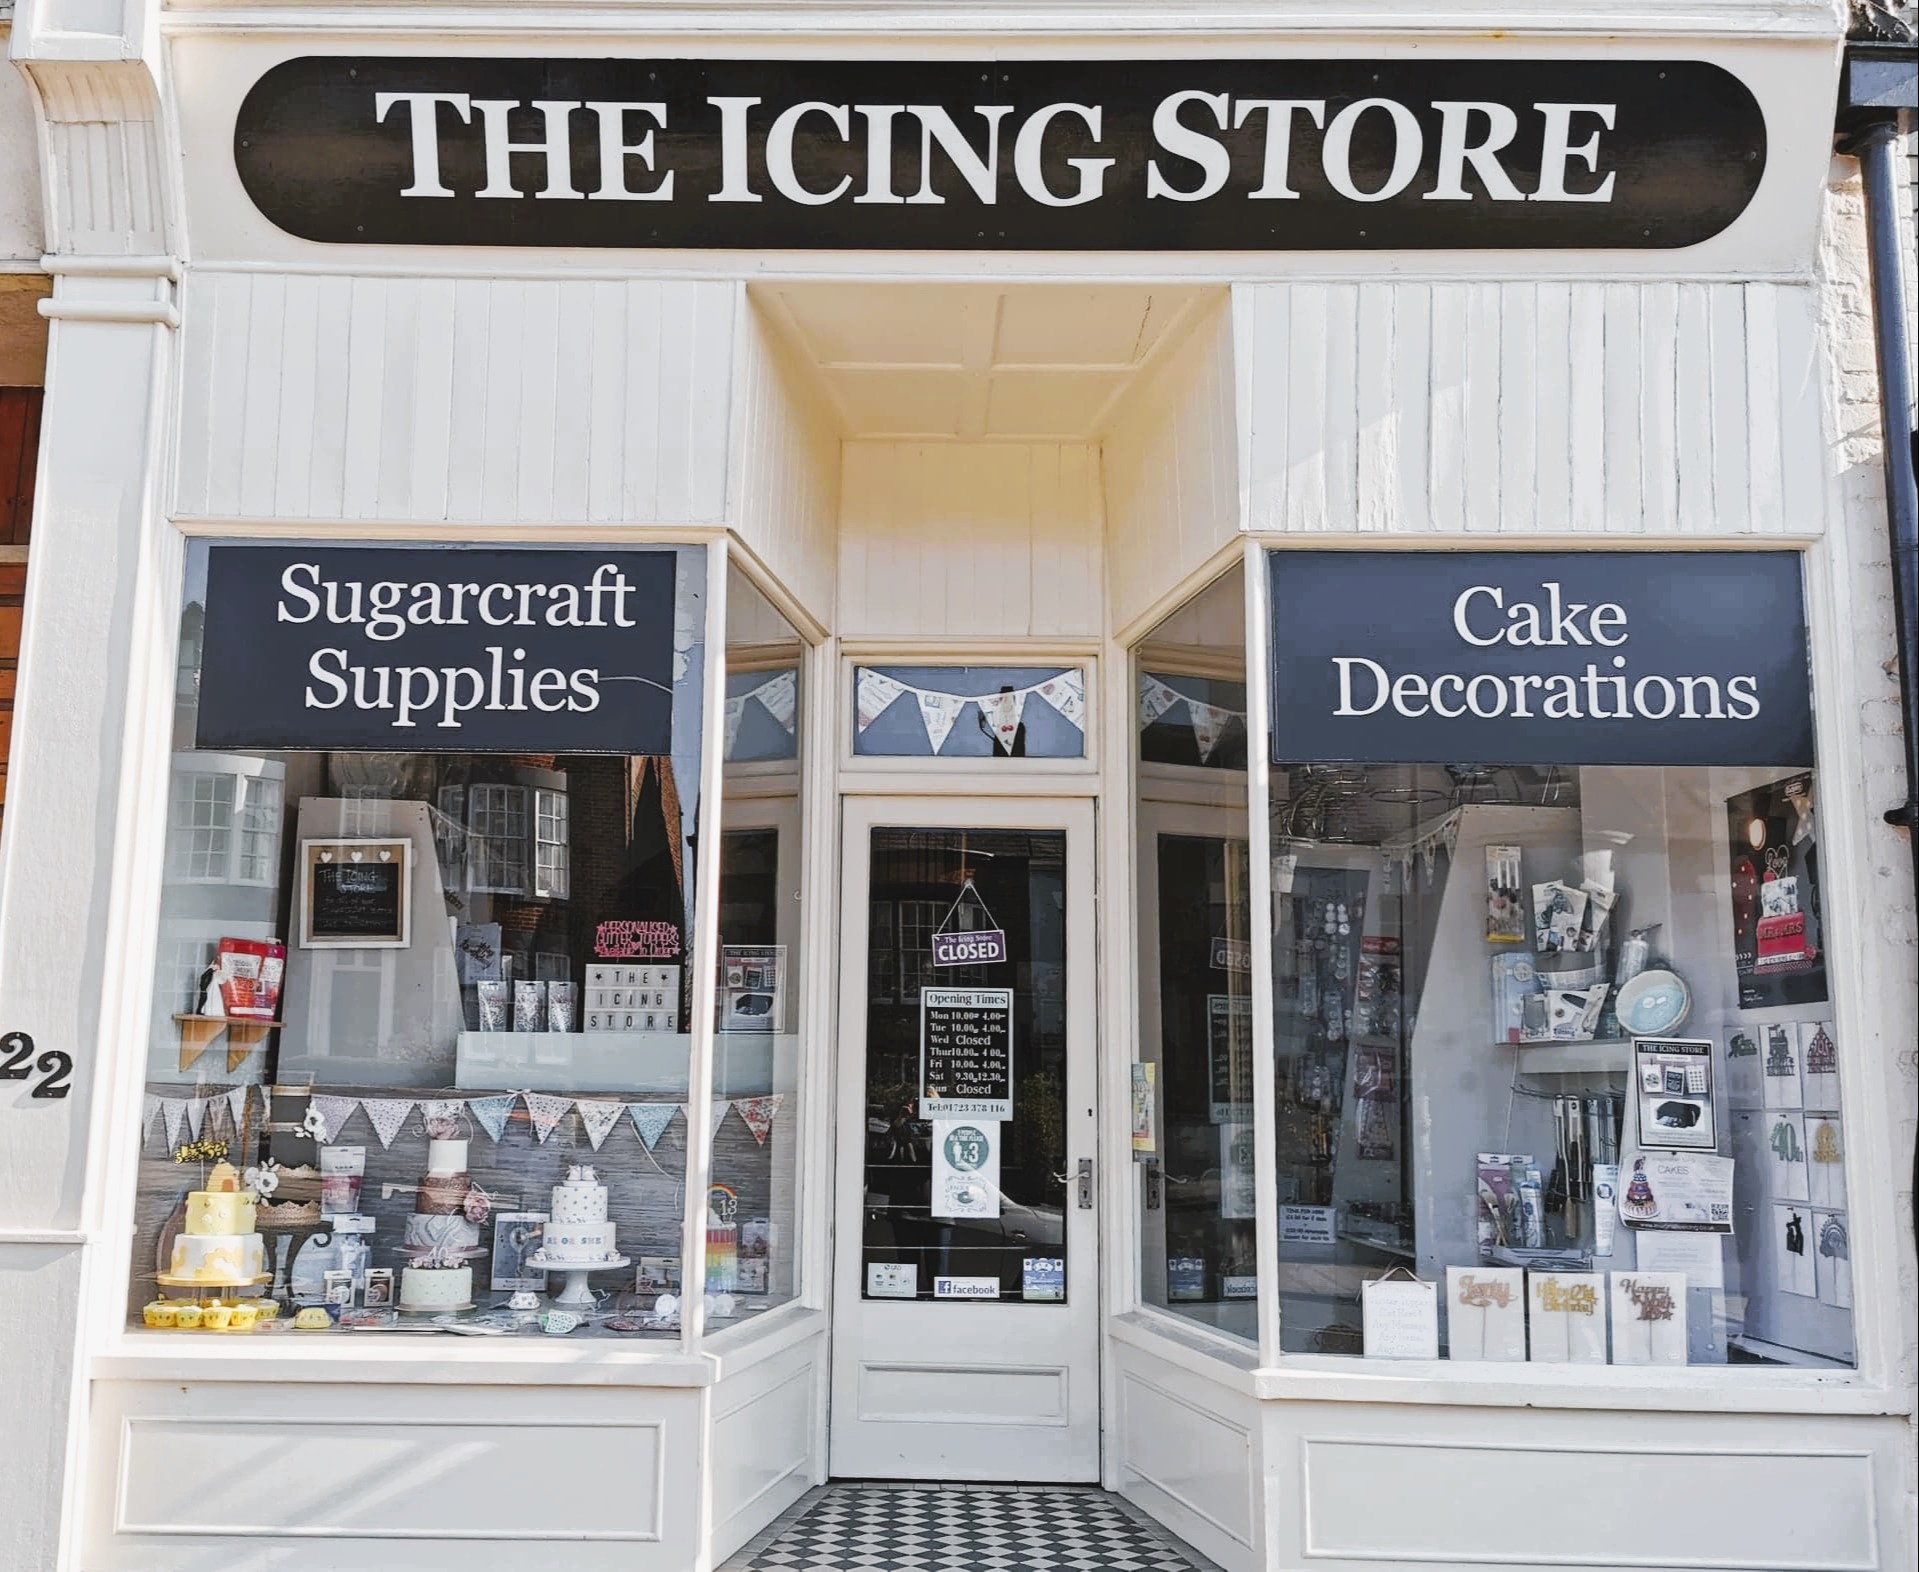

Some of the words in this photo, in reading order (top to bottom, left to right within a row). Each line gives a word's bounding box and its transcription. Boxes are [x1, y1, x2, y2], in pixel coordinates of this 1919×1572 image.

[375, 92, 674, 201] THE
[706, 96, 1116, 207] ICING
[1147, 90, 1617, 203] STORE
[277, 563, 636, 641] Sugarcraft
[1453, 582, 1629, 647] Cake
[305, 646, 600, 728] Supplies
[1331, 655, 1760, 720] Decorations
[938, 942, 1000, 961] CLOSED
[615, 971, 649, 983] THE
[599, 993, 663, 1005] ICING
[929, 993, 972, 1006] Opening
[975, 994, 1006, 1004] Times
[930, 1010, 949, 1020] Mon
[590, 1015, 673, 1028] STORE
[930, 1022, 947, 1032] Tue
[930, 1035, 949, 1044] Wed
[956, 1035, 991, 1046] Closed
[0, 1031, 73, 1098] 22
[929, 1059, 943, 1069] Fri
[929, 1071, 944, 1080] Sat
[956, 1084, 992, 1095] Closed
[1657, 1165, 1690, 1175] CAKES
[720, 1199, 738, 1216] 13
[953, 1283, 996, 1295] facebook
